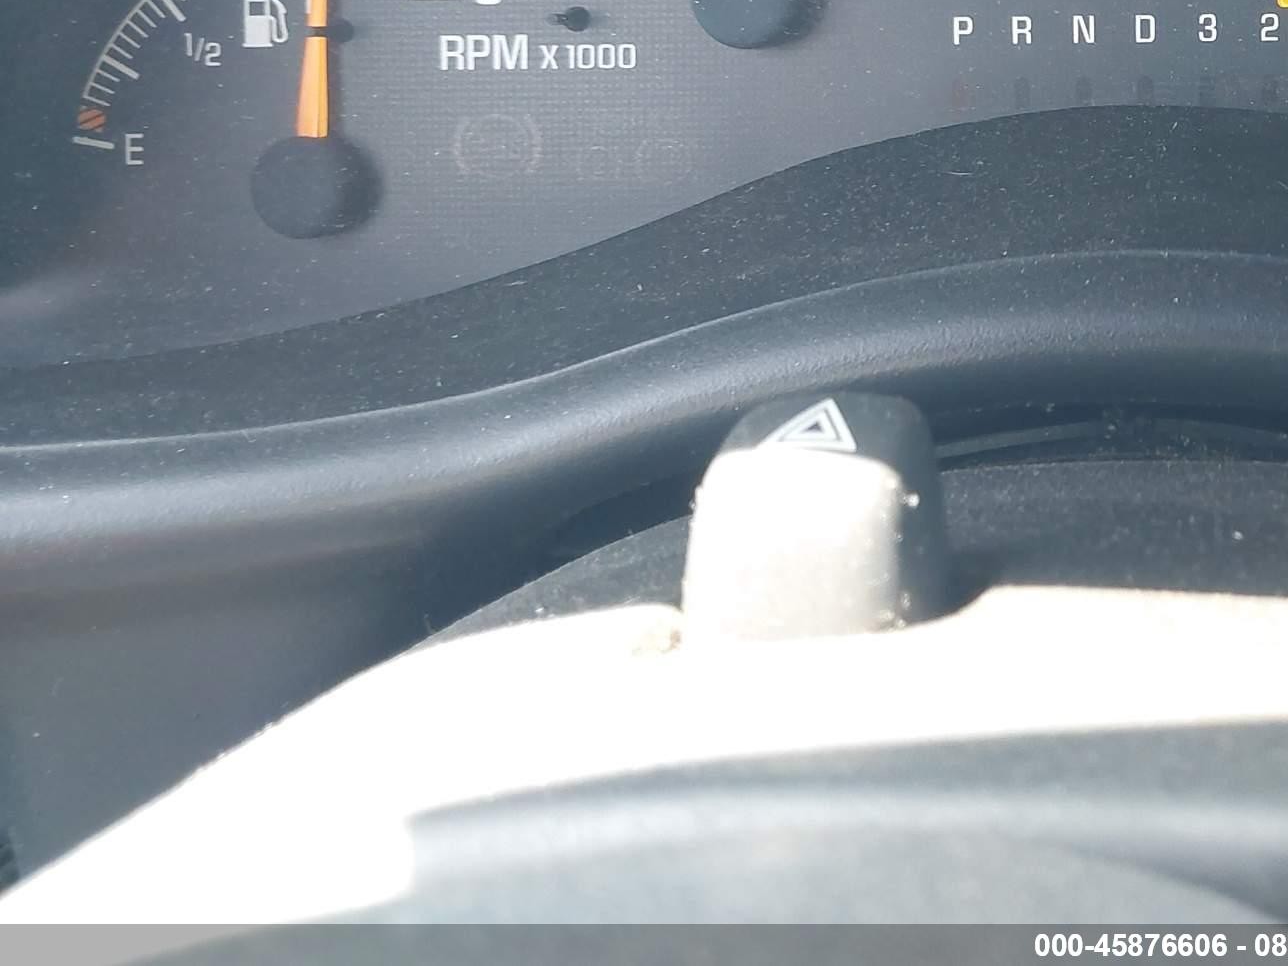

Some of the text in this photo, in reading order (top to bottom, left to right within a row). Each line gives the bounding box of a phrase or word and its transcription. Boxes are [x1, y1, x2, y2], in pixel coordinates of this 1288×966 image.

[953, 16, 973, 45] P
[1011, 16, 1032, 45] R
[1073, 15, 1095, 44] N
[1135, 14, 1156, 43] D
[1198, 13, 1217, 42] 3
[1260, 13, 1279, 42] 2
[440, 34, 528, 71] RPM
[565, 43, 636, 69] 1000
[125, 133, 144, 165] E
